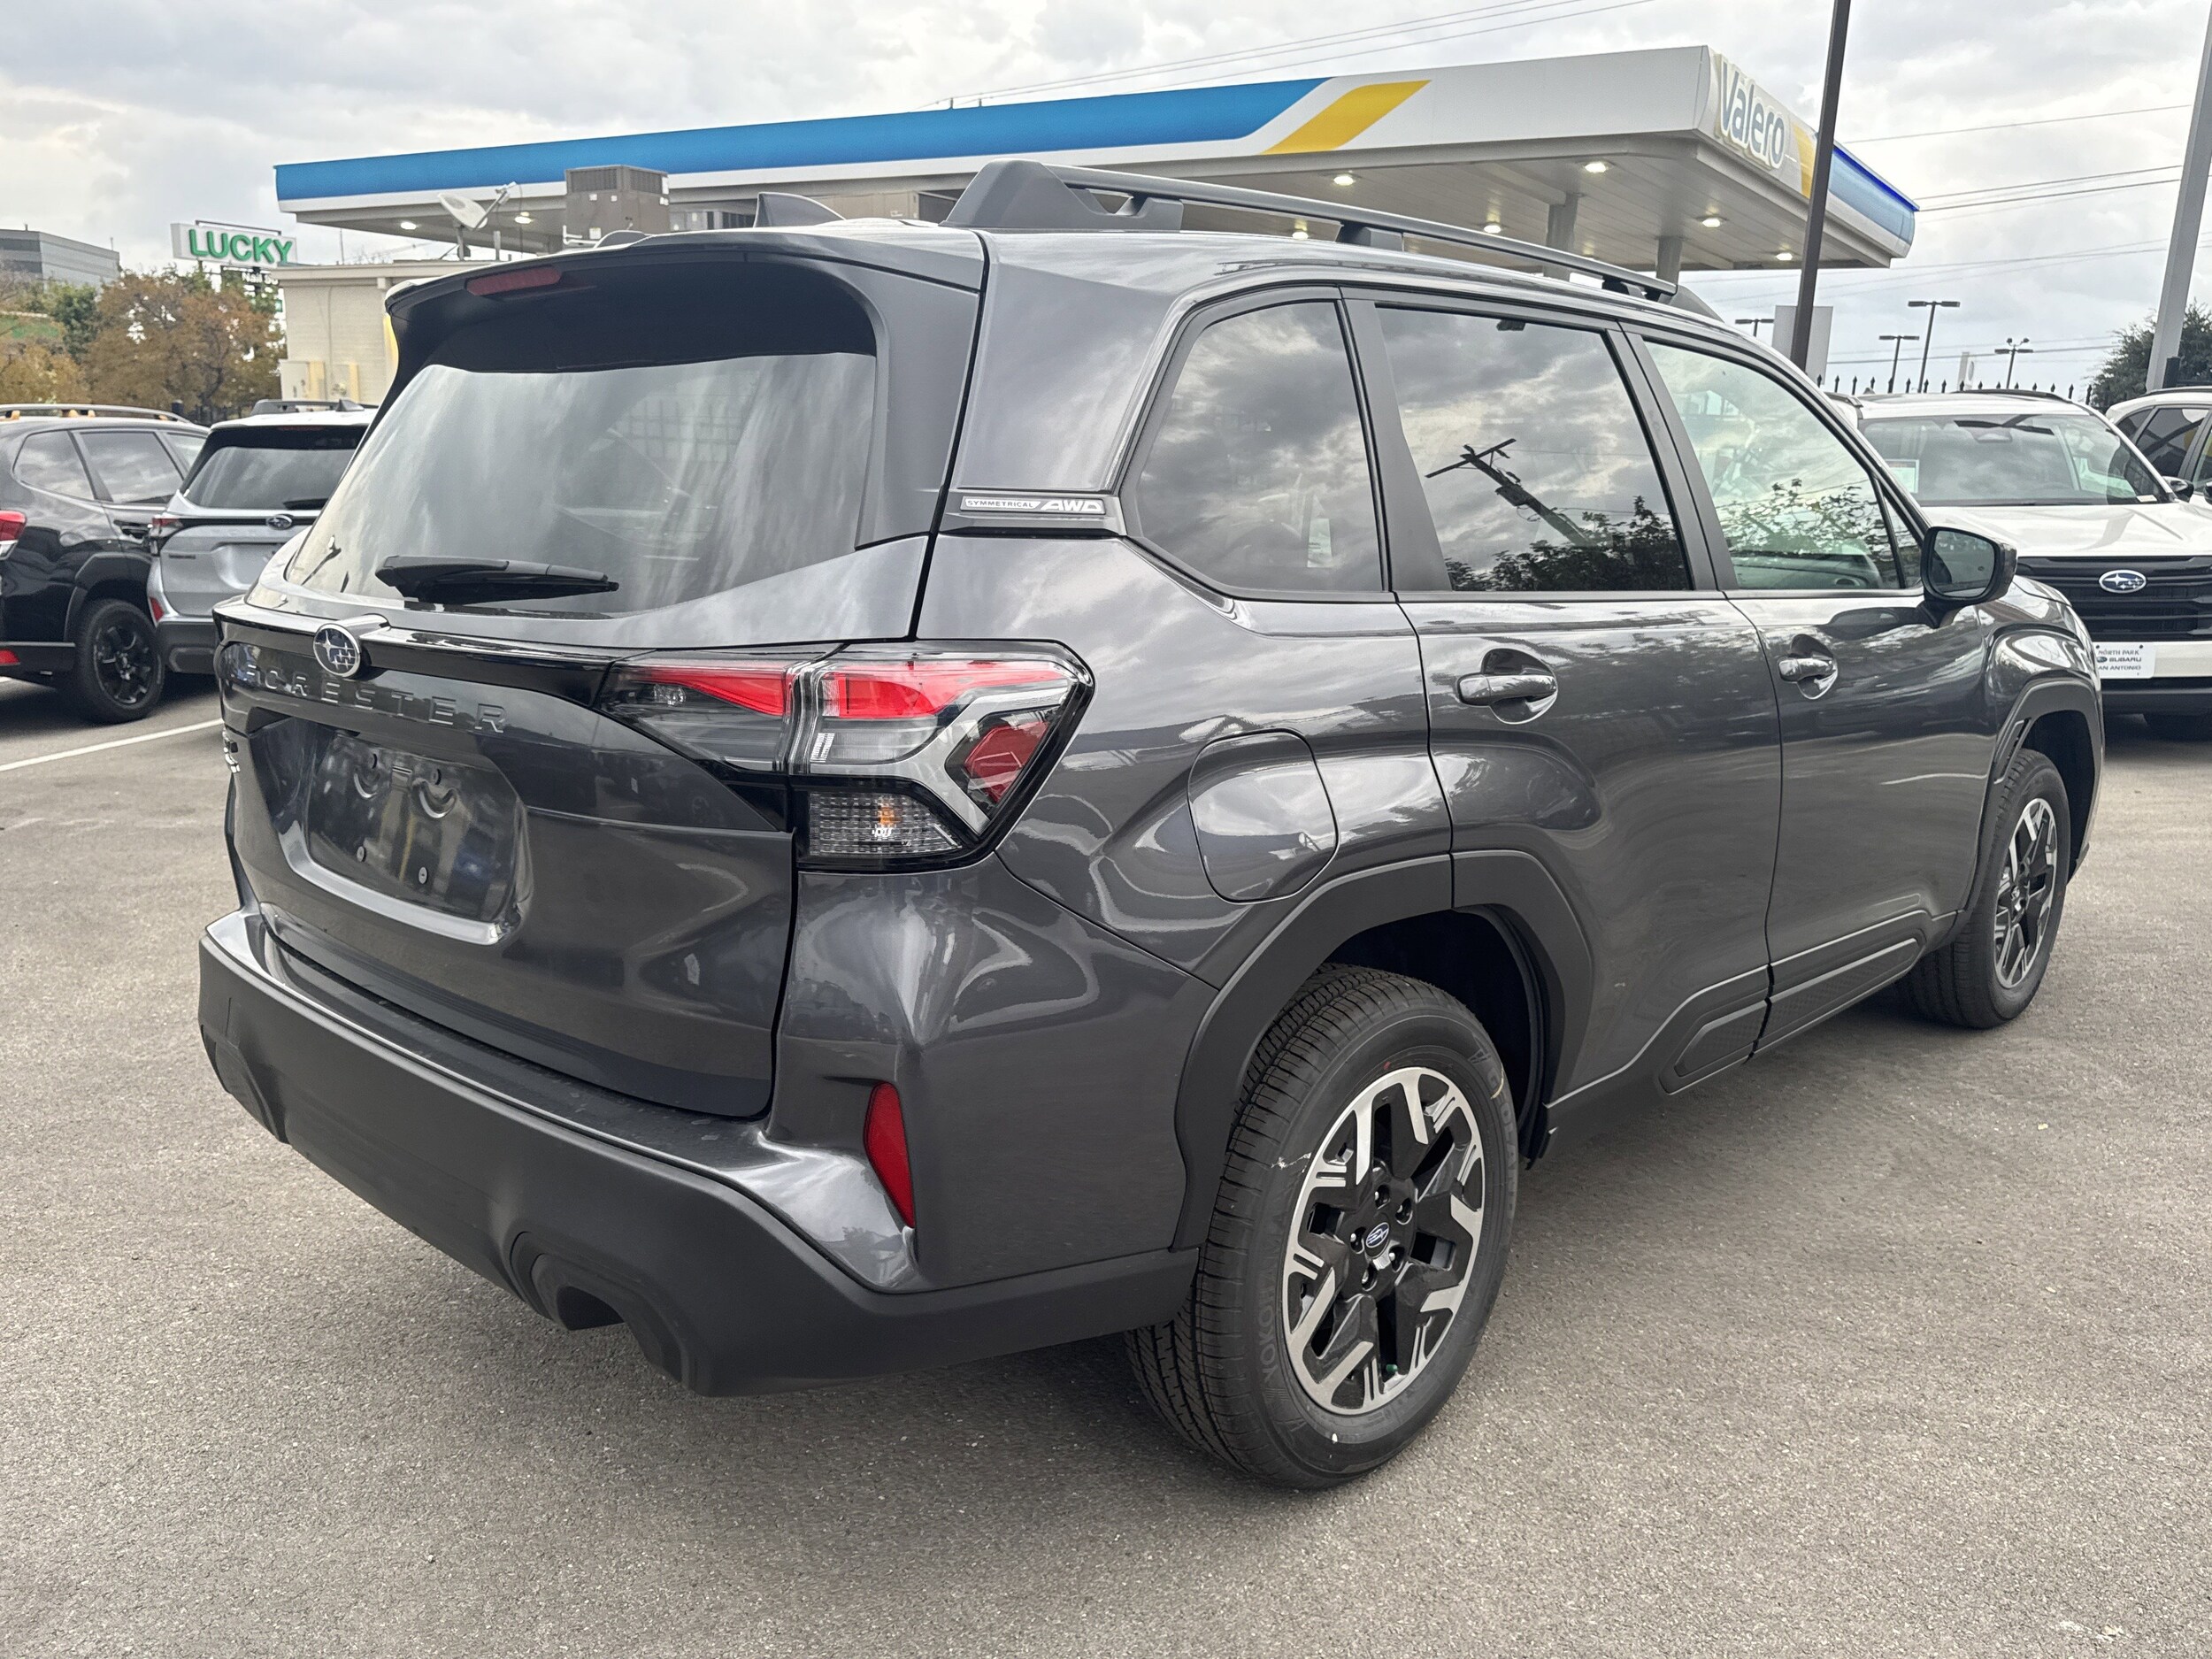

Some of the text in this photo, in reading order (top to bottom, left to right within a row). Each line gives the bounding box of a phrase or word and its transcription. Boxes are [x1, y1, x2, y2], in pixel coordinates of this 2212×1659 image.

[1722, 60, 1786, 165] Valero
[188, 228, 293, 264] LUCKY
[967, 499, 1102, 511] SYMMETRICAL AWD
[244, 663, 506, 733] FORESTER
